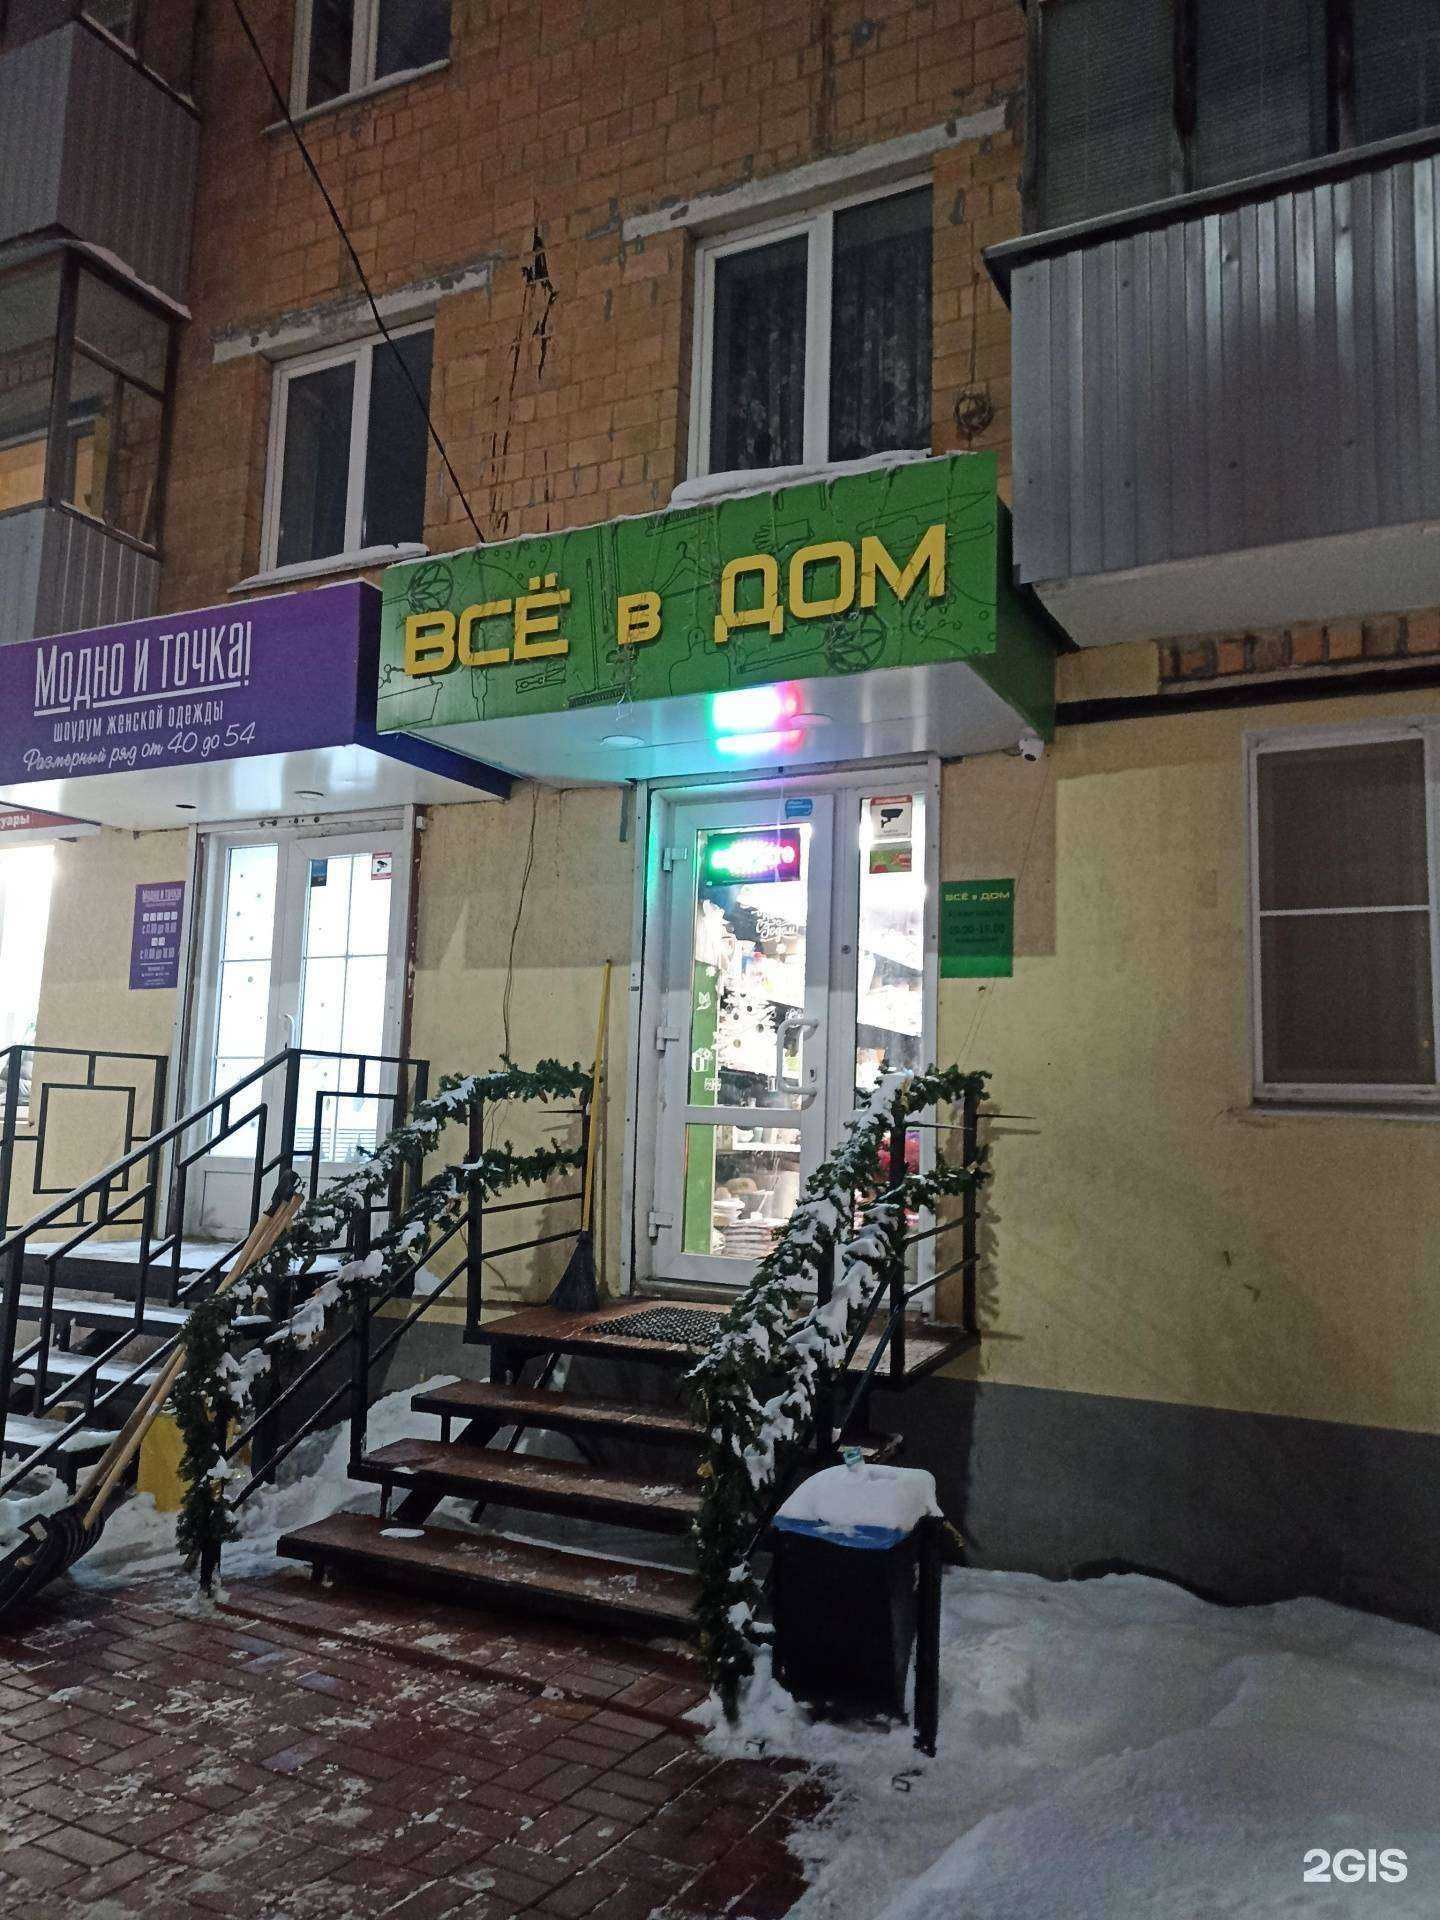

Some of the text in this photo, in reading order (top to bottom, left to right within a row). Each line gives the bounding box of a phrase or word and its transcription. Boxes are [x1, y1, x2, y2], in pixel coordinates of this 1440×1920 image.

[404, 573, 571, 677] ВСЁ
[714, 524, 946, 644] ДОМ
[23, 721, 256, 774] Размерный ряд от 40 до 54
[53, 700, 224, 744] шоурум женской одежды
